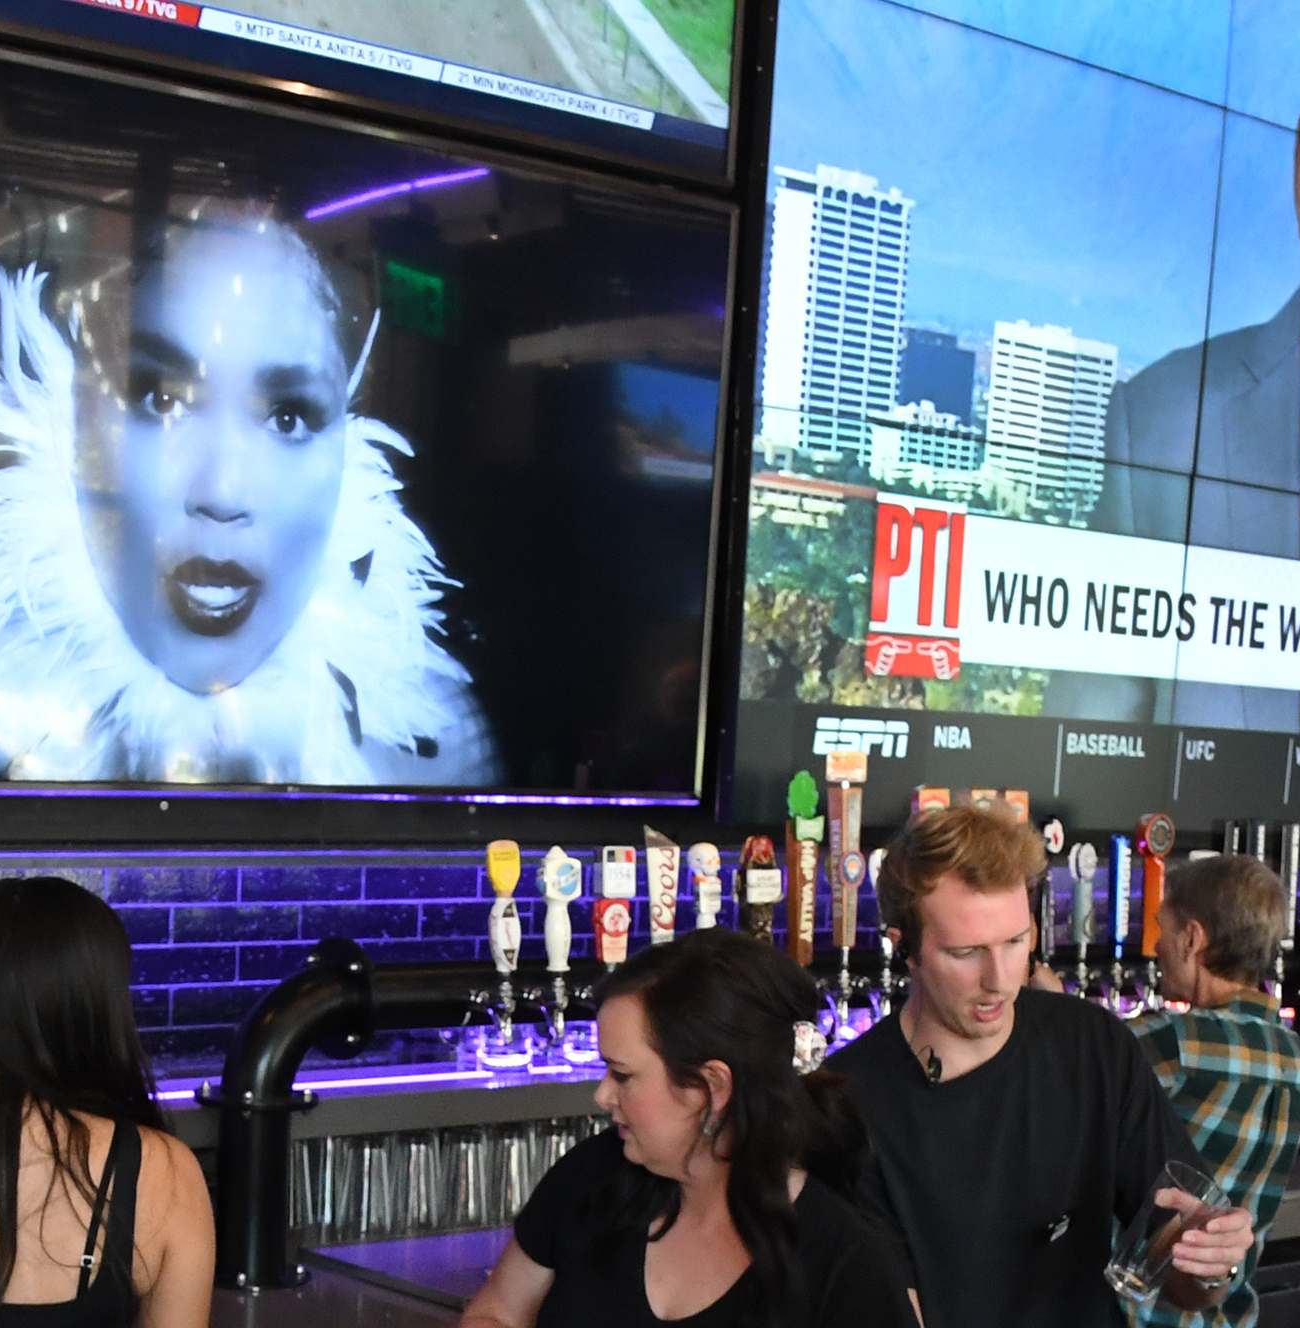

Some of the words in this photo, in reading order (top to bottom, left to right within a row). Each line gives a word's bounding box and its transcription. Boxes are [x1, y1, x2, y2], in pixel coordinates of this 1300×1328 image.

[278, 30, 323, 52] SANTA
[327, 40, 365, 61] ANITA
[387, 54, 414, 72] TVG
[473, 74, 494, 92] MIN
[497, 80, 566, 107] MONMOUTH
[568, 96, 597, 113] PARK
[617, 108, 640, 124] TVG
[870, 502, 966, 629] PTI
[984, 569, 1070, 630] WHO
[1085, 581, 1197, 642] NEEDS
[1209, 596, 1269, 649] THE
[812, 716, 911, 759] ESPN
[933, 725, 972, 750] NBA
[1066, 732, 1146, 758] BASEBALL
[1185, 740, 1217, 762] UFC
[799, 838, 818, 882] HOP
[651, 846, 677, 933] Coors
[798, 882, 815, 944] VALLEY
